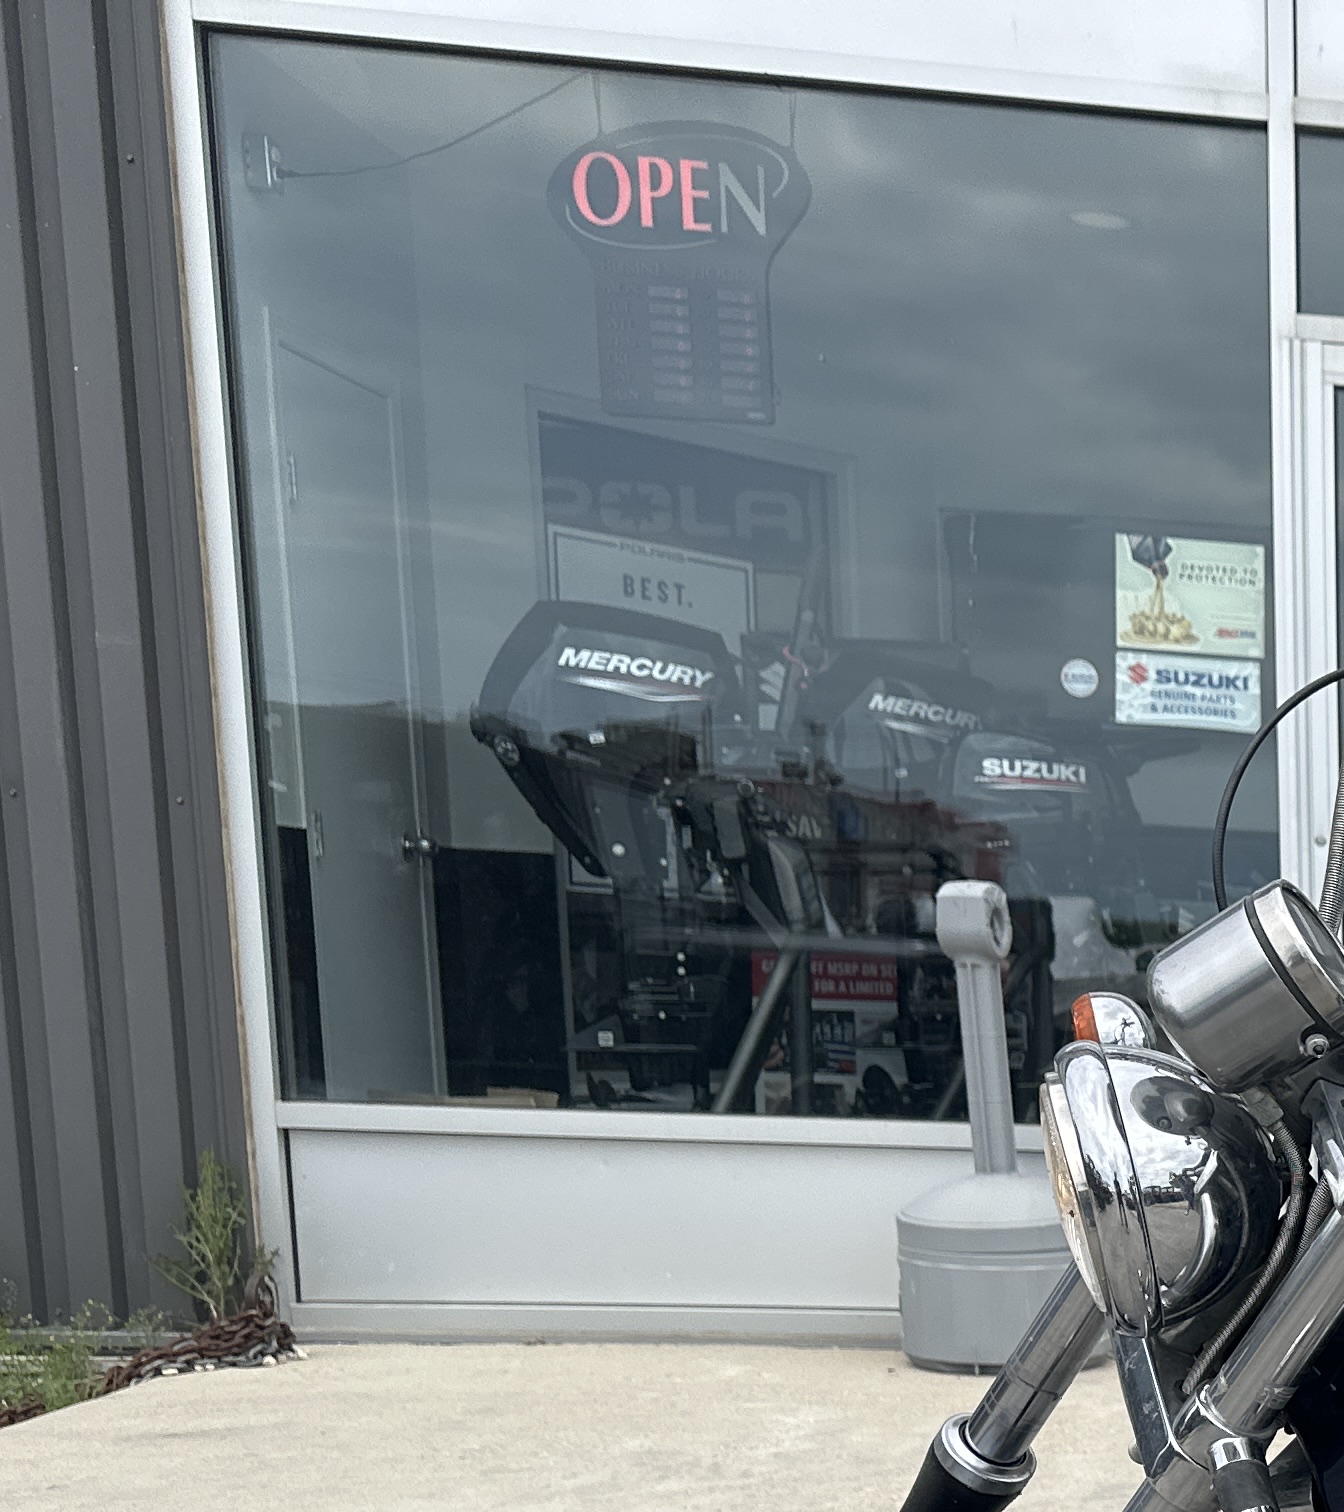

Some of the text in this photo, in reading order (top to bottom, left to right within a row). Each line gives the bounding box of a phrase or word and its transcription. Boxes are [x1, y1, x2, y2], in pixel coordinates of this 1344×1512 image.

[572, 151, 767, 237] OPEN
[1178, 572, 1257, 587] PROTECTION
[1180, 562, 1258, 579] DEVOTED TO
[622, 573, 693, 609] BEST.
[558, 647, 715, 688] MERCURY
[1155, 667, 1249, 692] SUZUKI
[1150, 689, 1237, 706] GENUINE PARTS
[868, 693, 982, 731] MERCUR
[1162, 702, 1238, 720] ACCESSORIES
[982, 757, 1087, 785] SUZUKI
